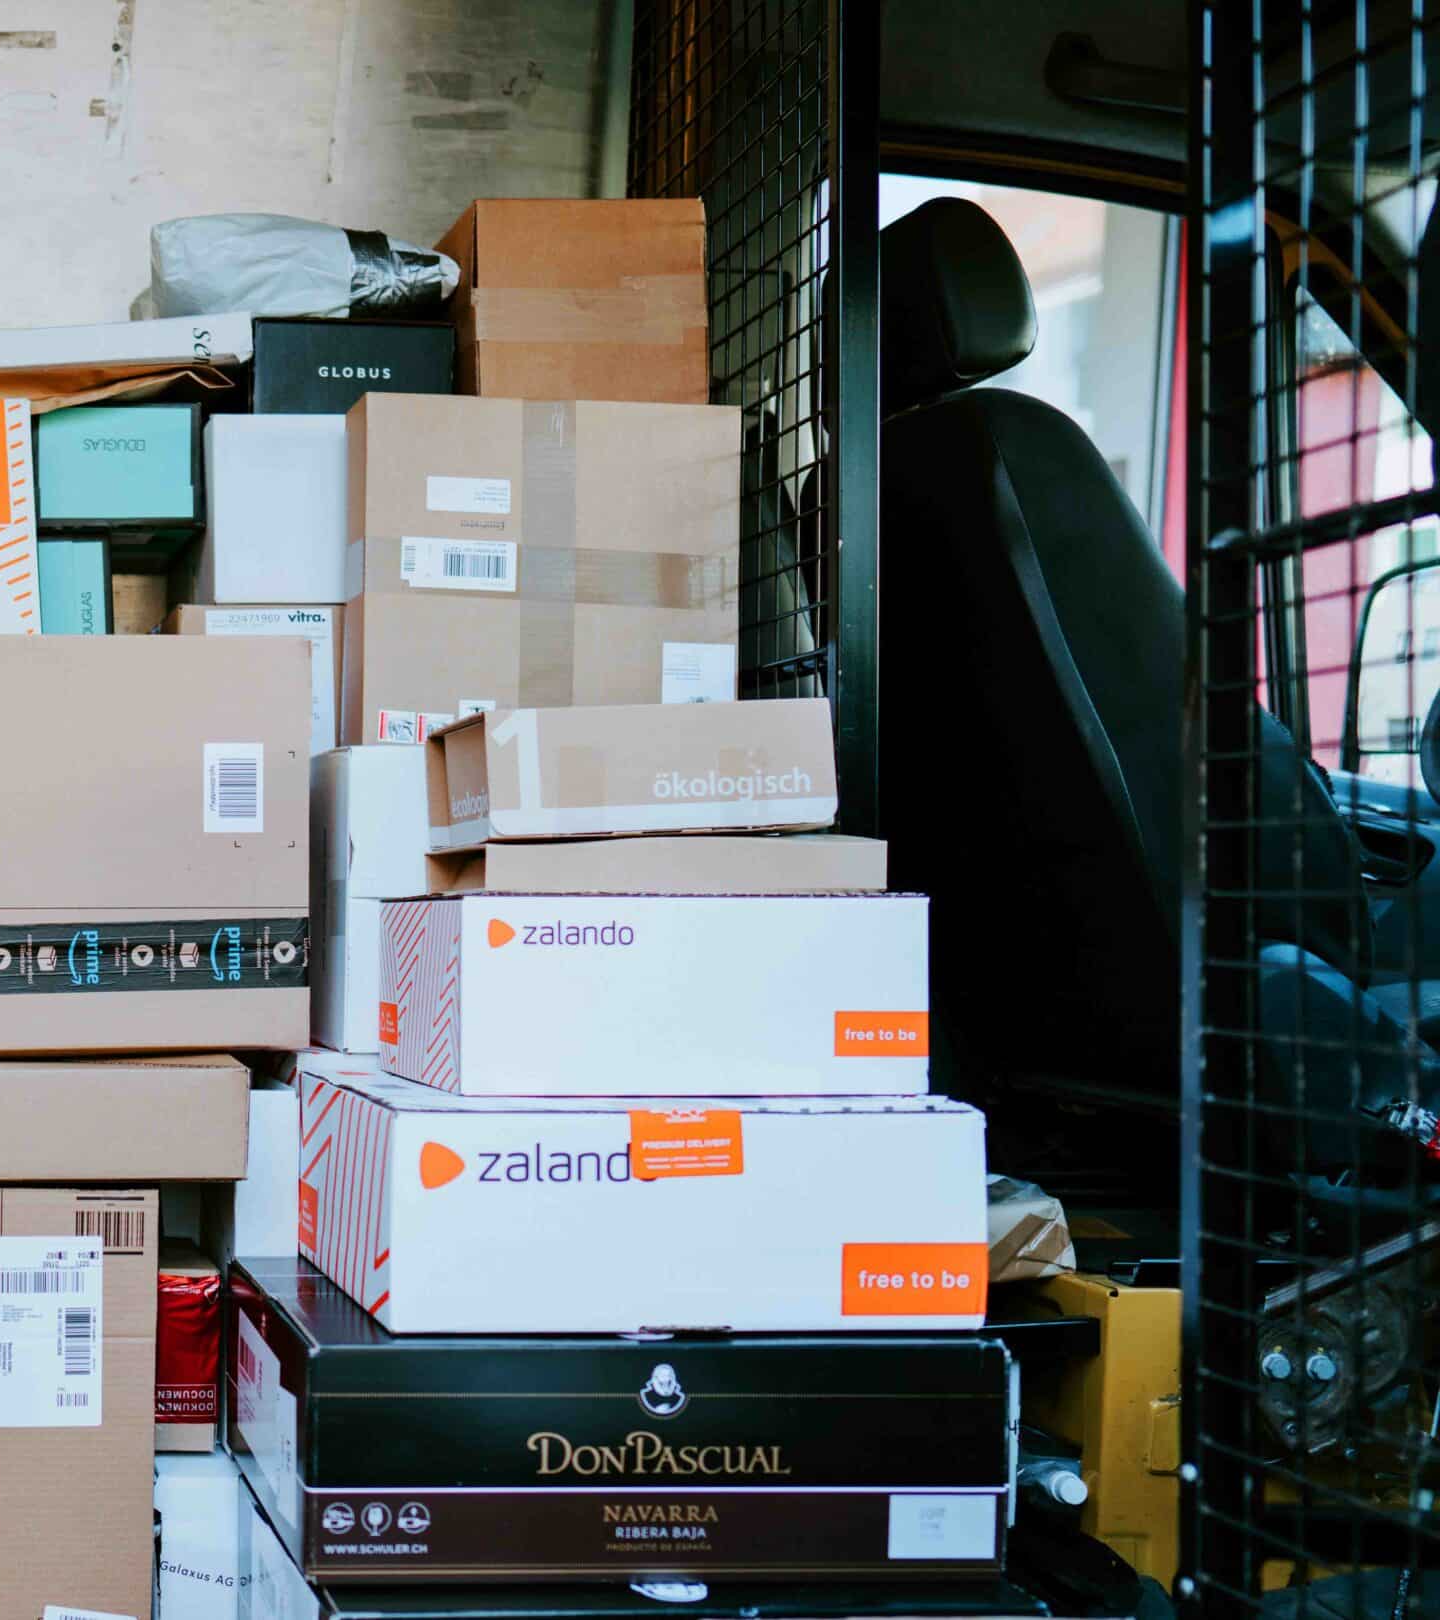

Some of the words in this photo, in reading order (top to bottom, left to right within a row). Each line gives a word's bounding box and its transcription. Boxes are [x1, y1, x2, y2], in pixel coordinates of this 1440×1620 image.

[318, 365, 392, 380] GLOBUS
[288, 610, 326, 623] vitra.
[653, 766, 812, 801] ökologisch
[522, 920, 635, 946] zalando
[80, 929, 101, 985] prime
[224, 926, 245, 982] prime
[844, 1028, 874, 1041] free
[879, 1029, 894, 1041] to
[898, 1028, 917, 1041] be
[478, 1143, 629, 1183] zaland
[858, 1269, 905, 1290] free
[910, 1270, 935, 1290] to
[940, 1269, 971, 1290] be
[155, 1402, 214, 1412] DOKUMEN
[603, 1504, 719, 1522] NAVARRA
[615, 1526, 668, 1539] RIBERA
[672, 1526, 706, 1540] BAJA
[324, 1543, 428, 1555] WWW.SCHULER.CH
[160, 1560, 212, 1582] Galaxus
[216, 1575, 235, 1588] AG
